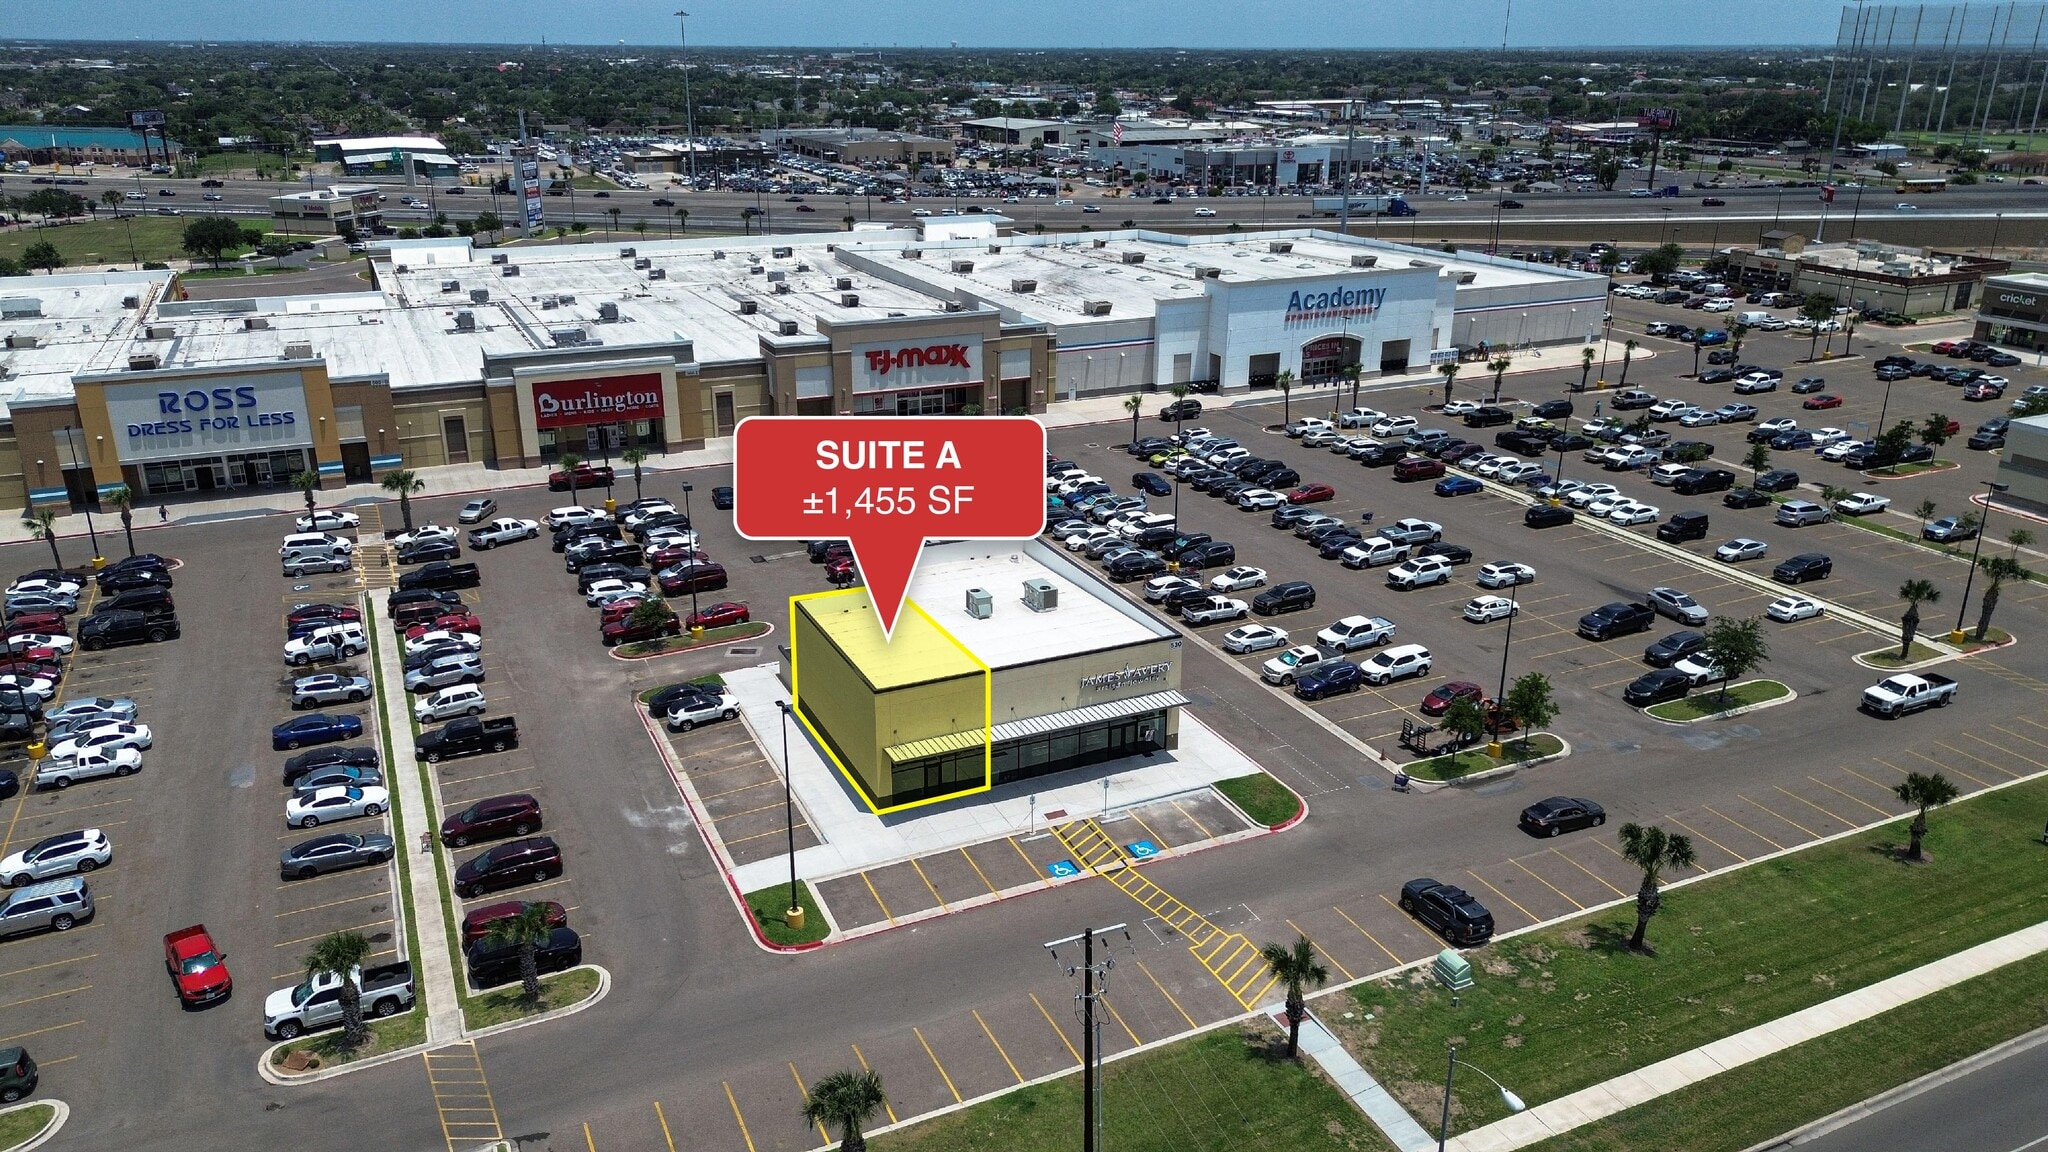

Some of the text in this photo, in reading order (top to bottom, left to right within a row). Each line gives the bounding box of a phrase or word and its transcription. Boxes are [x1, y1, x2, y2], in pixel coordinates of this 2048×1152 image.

[1287, 286, 1387, 312] Academy
[2000, 293, 2037, 306] cricket
[158, 386, 257, 414] ROSS
[538, 391, 659, 413] Burlington
[127, 411, 295, 438] DRESS FOR LESS
[1080, 662, 1173, 689] JAMES AVERY
